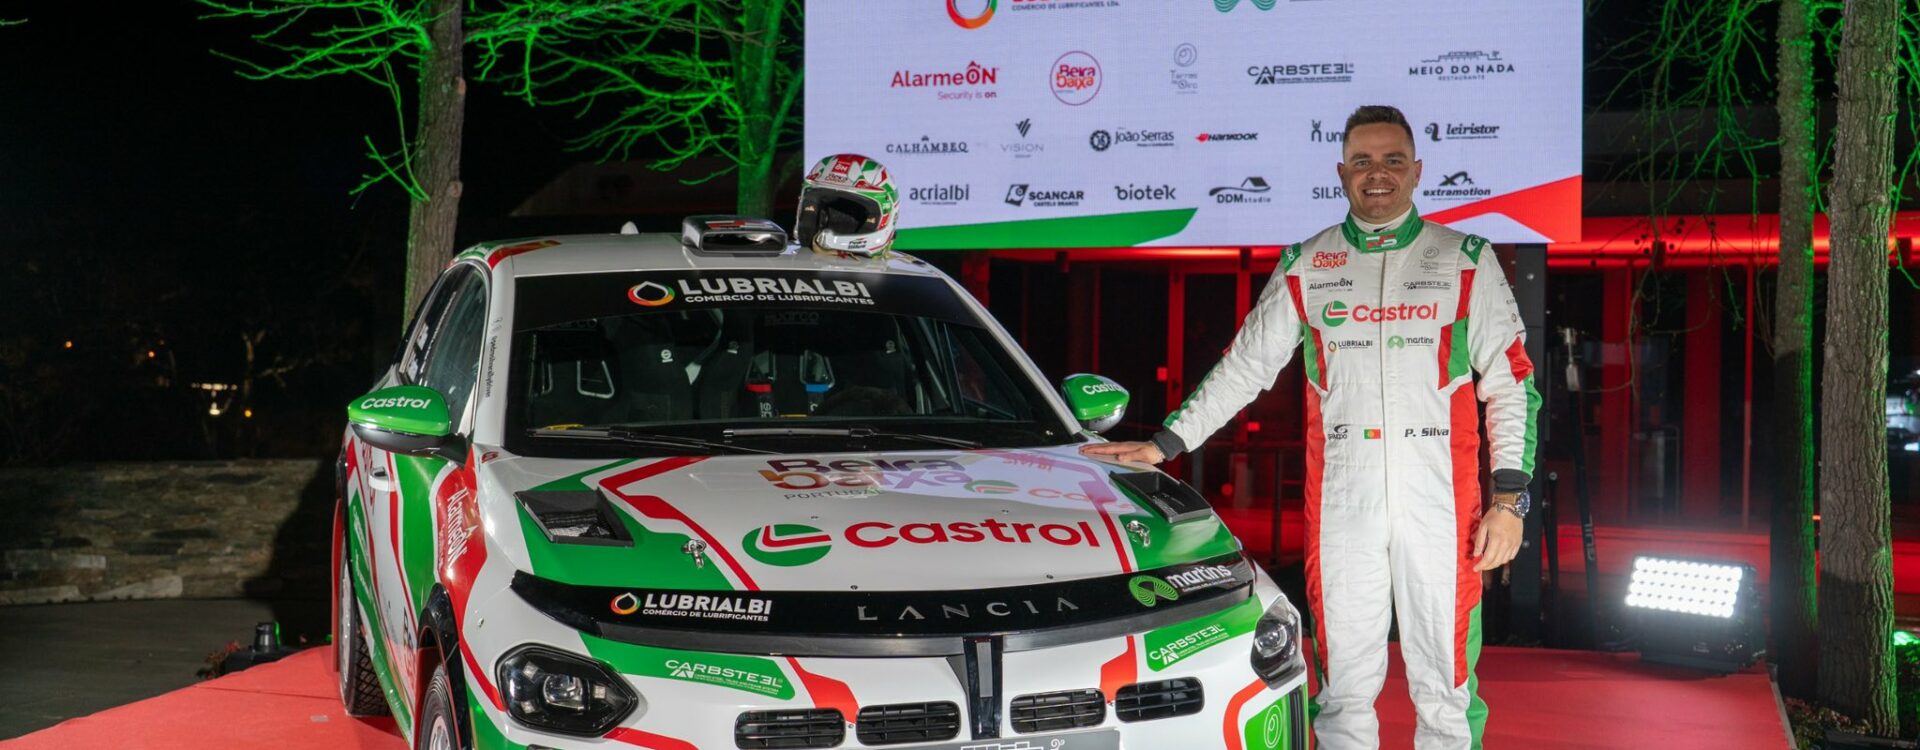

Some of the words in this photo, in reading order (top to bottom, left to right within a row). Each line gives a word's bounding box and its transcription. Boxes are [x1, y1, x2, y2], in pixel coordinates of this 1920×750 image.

[1059, 64, 1096, 77] Beira
[1409, 67, 1444, 75] MEIO
[1451, 66, 1470, 74] DO
[1476, 64, 1515, 73] NADA
[938, 91, 973, 100] Security
[1446, 124, 1500, 135] leiristor
[1114, 131, 1140, 144] João
[1141, 130, 1174, 142] Serras
[1001, 143, 1044, 152] VISION
[909, 184, 969, 200] acrialbi
[1029, 191, 1084, 200] SCANCAR
[1114, 184, 1176, 200] biotek
[1423, 187, 1491, 196] extramotion
[1315, 251, 1348, 260] Beira
[678, 278, 871, 298] LUBRIALBI
[685, 295, 754, 303] COMERCIO
[780, 294, 875, 305] LUBRIFICANTES
[1352, 302, 1438, 323] Castrol
[360, 396, 431, 410] Castrol
[1405, 428, 1416, 437] P.
[1421, 427, 1449, 436] Silva
[844, 518, 1101, 548] Castrol
[1166, 565, 1232, 589] martins
[644, 593, 772, 615] LUBRIALBI
[857, 597, 1079, 621] LANCIA
[642, 607, 687, 616] COMÉRCIO
[702, 611, 769, 622] LUBRIFICANTES
